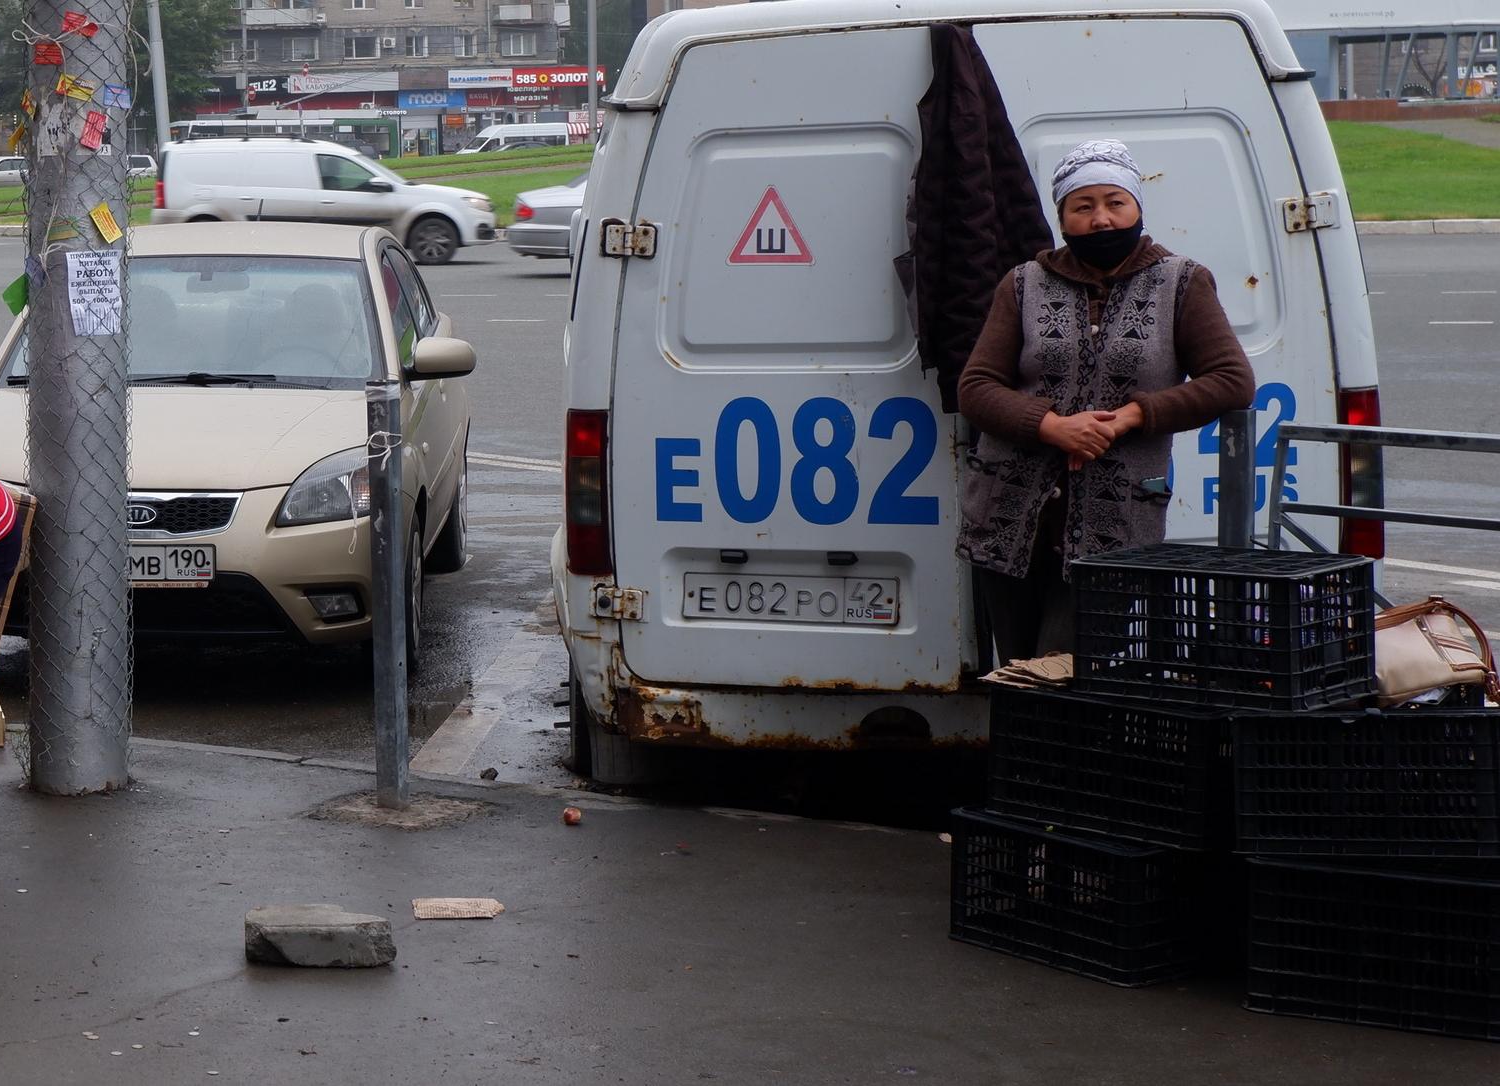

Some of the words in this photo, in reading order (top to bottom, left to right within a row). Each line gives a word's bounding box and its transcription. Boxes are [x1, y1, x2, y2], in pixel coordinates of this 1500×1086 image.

[516, 74, 537, 84] 585
[550, 70, 604, 83] ЗОЛОТЙ
[408, 91, 447, 105] mobi
[756, 228, 786, 254] Ш
[78, 259, 112, 267] ПИТАНИЕ
[76, 269, 115, 279] РАБОТА
[78, 288, 114, 296] ВЫПЛАТЫ
[168, 549, 207, 568] 190
[177, 568, 196, 577] RUS
[699, 580, 838, 618] Е082РО
[849, 581, 885, 609] 42
[846, 607, 873, 619] RUS
